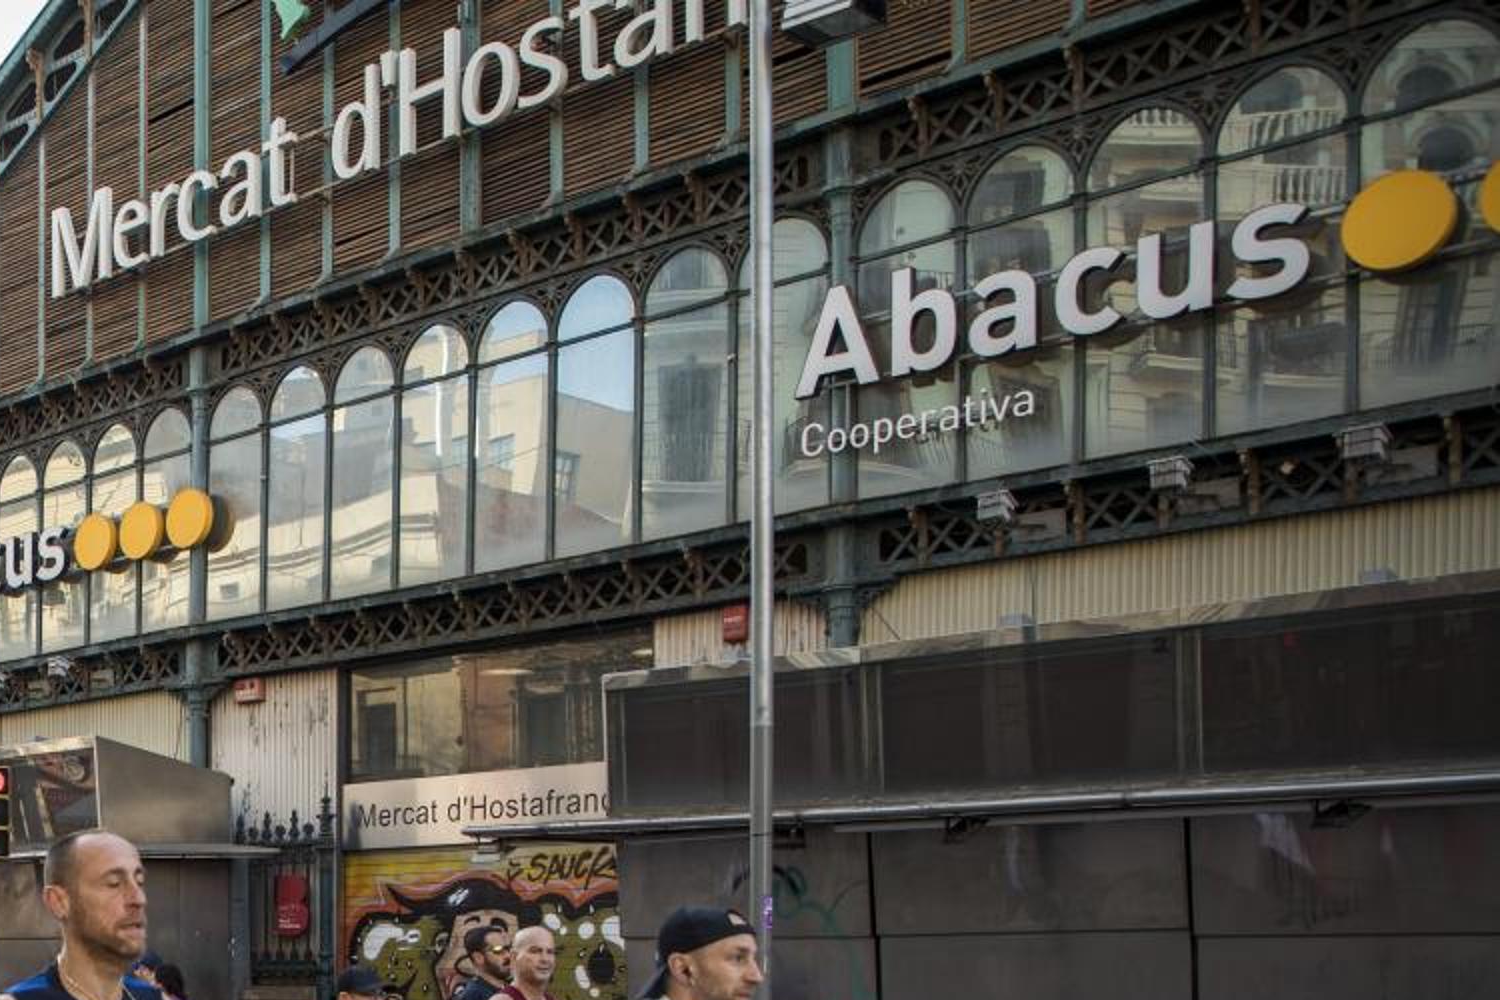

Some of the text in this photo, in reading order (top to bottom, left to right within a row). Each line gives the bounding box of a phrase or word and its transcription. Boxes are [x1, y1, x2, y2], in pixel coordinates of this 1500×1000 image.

[51, 0, 749, 299] Mercat d'Hosta
[796, 203, 1312, 399] Abacus
[800, 385, 1036, 458] Cooperativa
[357, 801, 438, 829] Mercat
